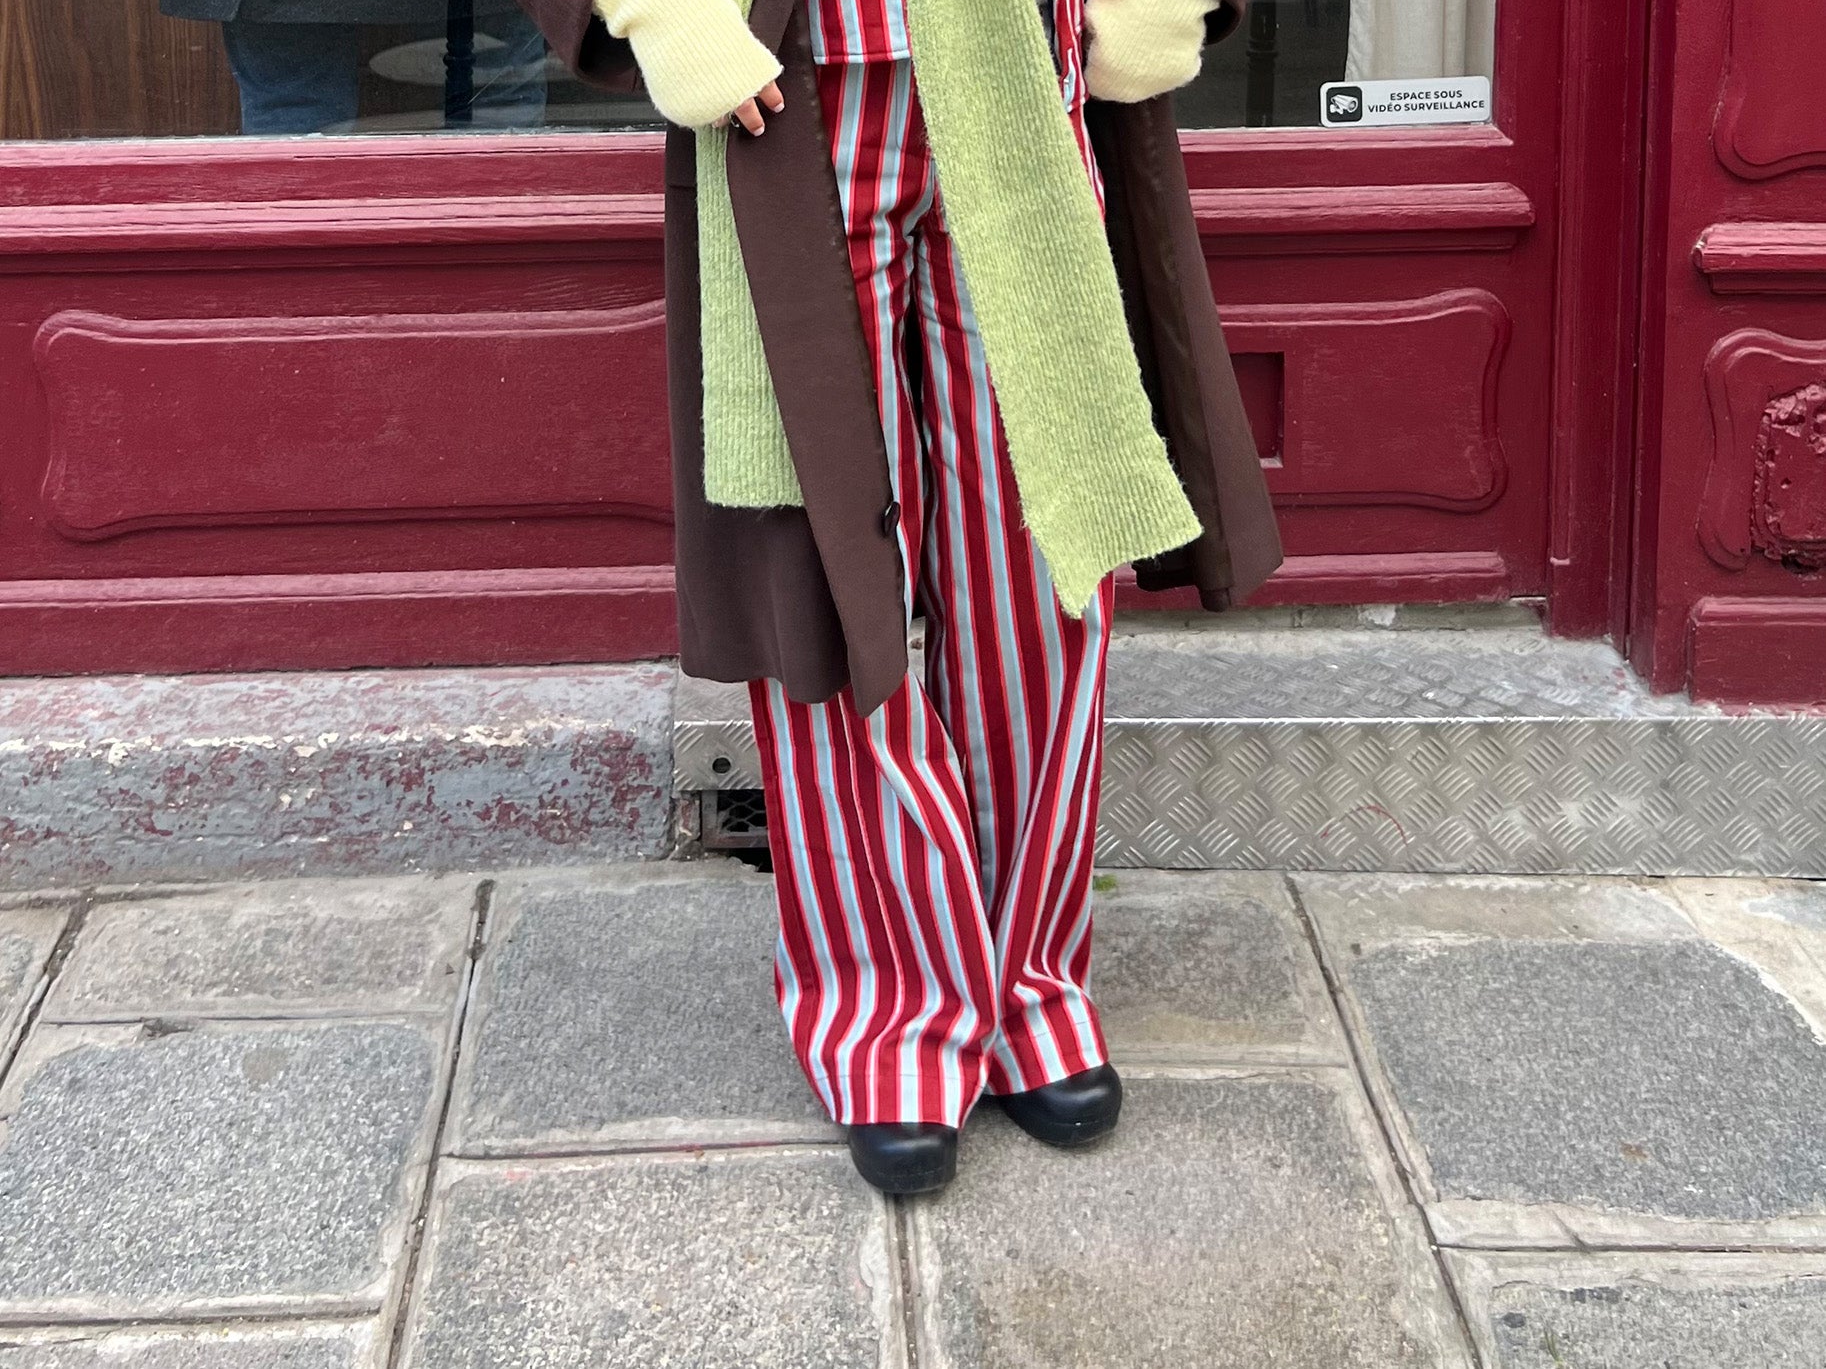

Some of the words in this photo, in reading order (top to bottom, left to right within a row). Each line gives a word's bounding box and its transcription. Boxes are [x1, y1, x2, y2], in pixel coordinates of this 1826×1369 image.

[1390, 91, 1432, 101] ESPACE
[1433, 90, 1463, 99] SOUS
[1368, 103, 1401, 113] VIDÉO
[1404, 100, 1485, 112] SURVEILLANCE
